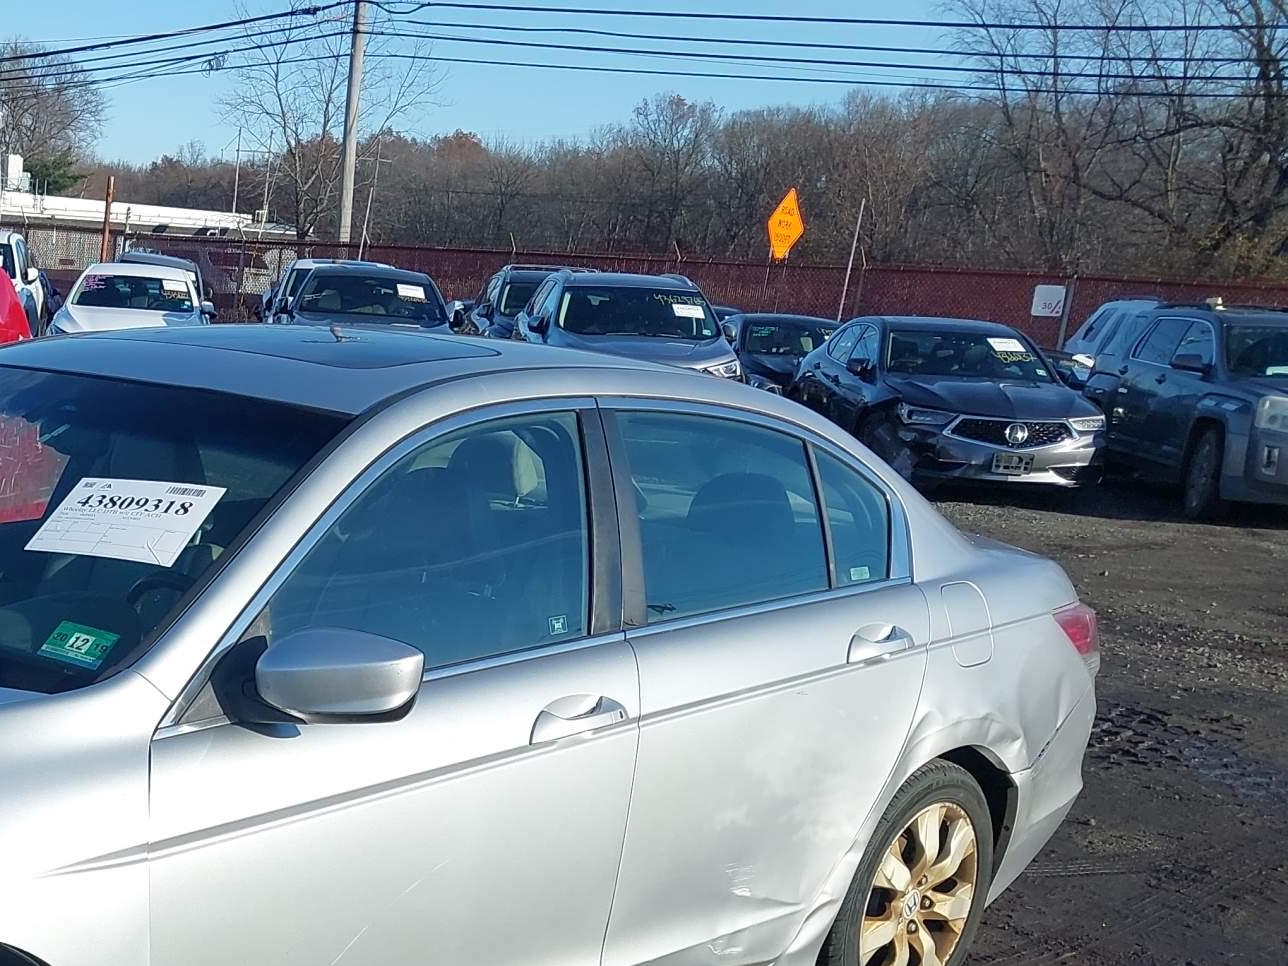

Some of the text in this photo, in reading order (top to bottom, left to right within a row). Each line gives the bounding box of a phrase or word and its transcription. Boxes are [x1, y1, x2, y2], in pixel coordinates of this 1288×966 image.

[77, 494, 194, 516] 43809318
[53, 632, 68, 641] 20
[68, 635, 90, 650] 12
[93, 643, 108, 653] 19
